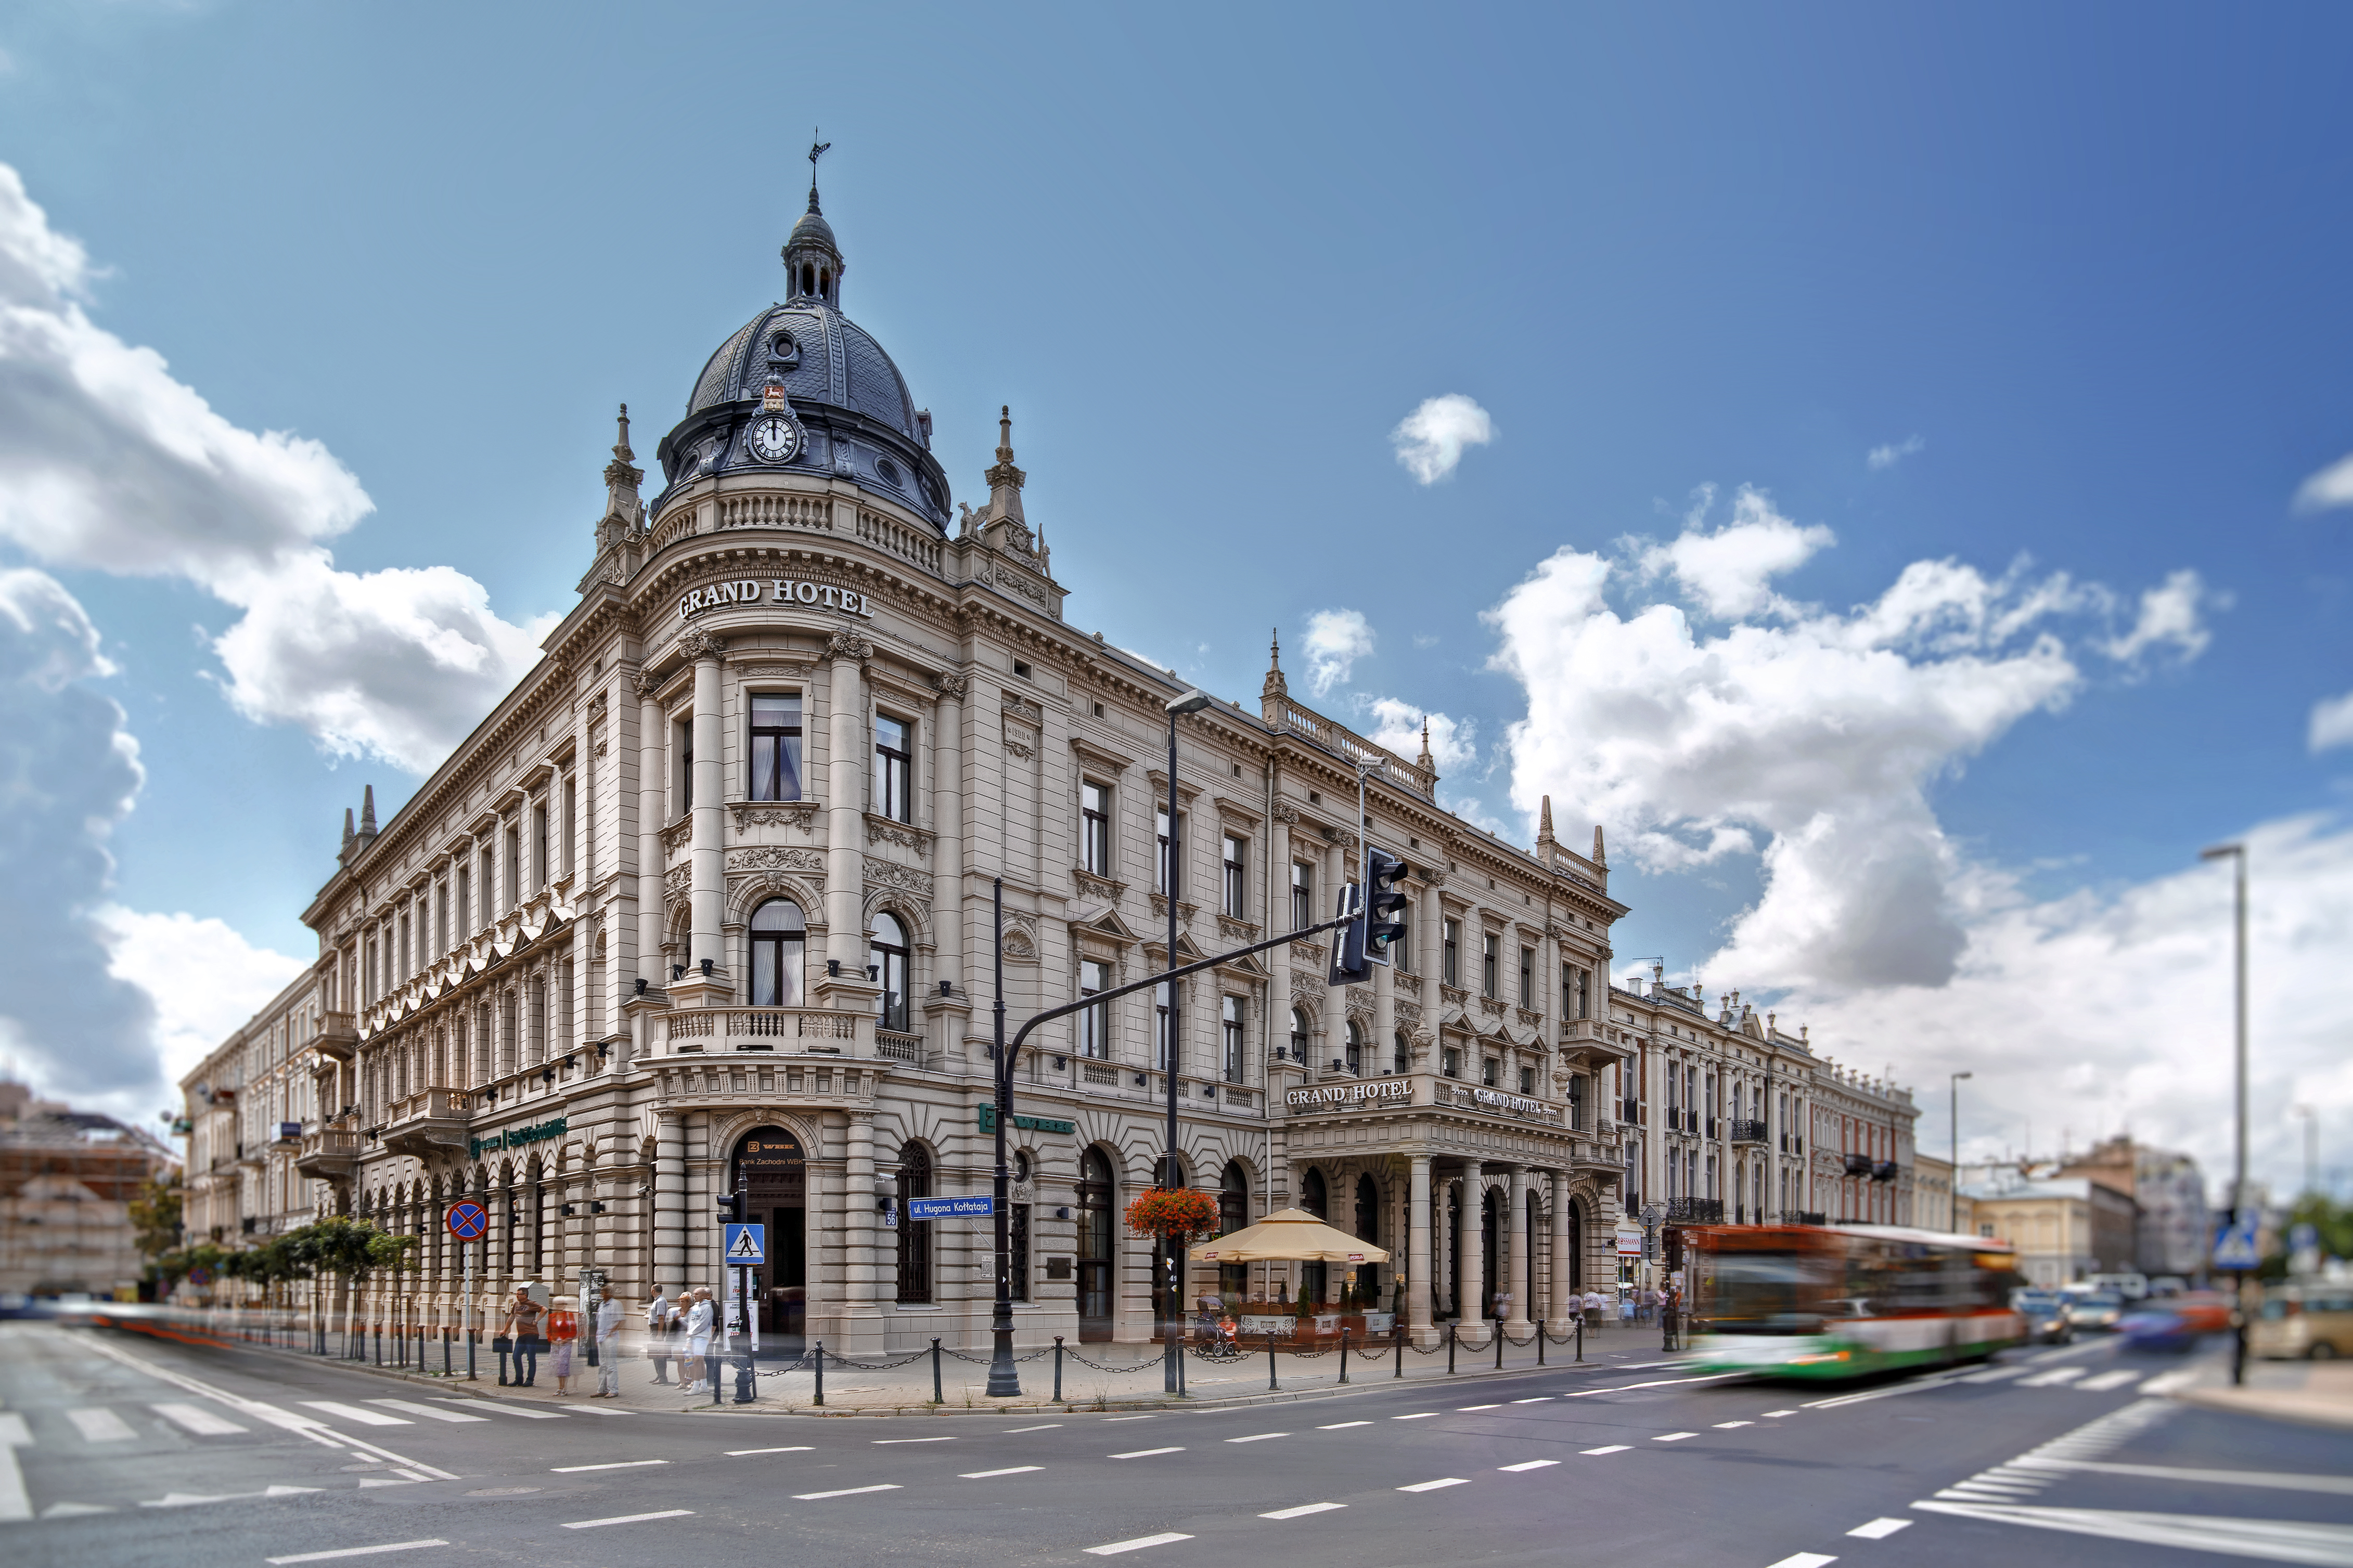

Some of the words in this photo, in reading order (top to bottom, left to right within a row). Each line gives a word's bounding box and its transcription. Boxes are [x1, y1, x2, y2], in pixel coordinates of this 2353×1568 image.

[679, 579, 761, 619] GRAND
[771, 579, 875, 618] HOTEL
[1287, 1087, 1345, 1105] GRAND
[1353, 1081, 1415, 1100] HOTEL
[1474, 1088, 1509, 1107] GRAND
[1512, 1097, 1541, 1114] HOTEL
[888, 1213, 895, 1225] 56
[924, 1203, 951, 1215] Hugona
[954, 1201, 988, 1213] Kołłątaja
